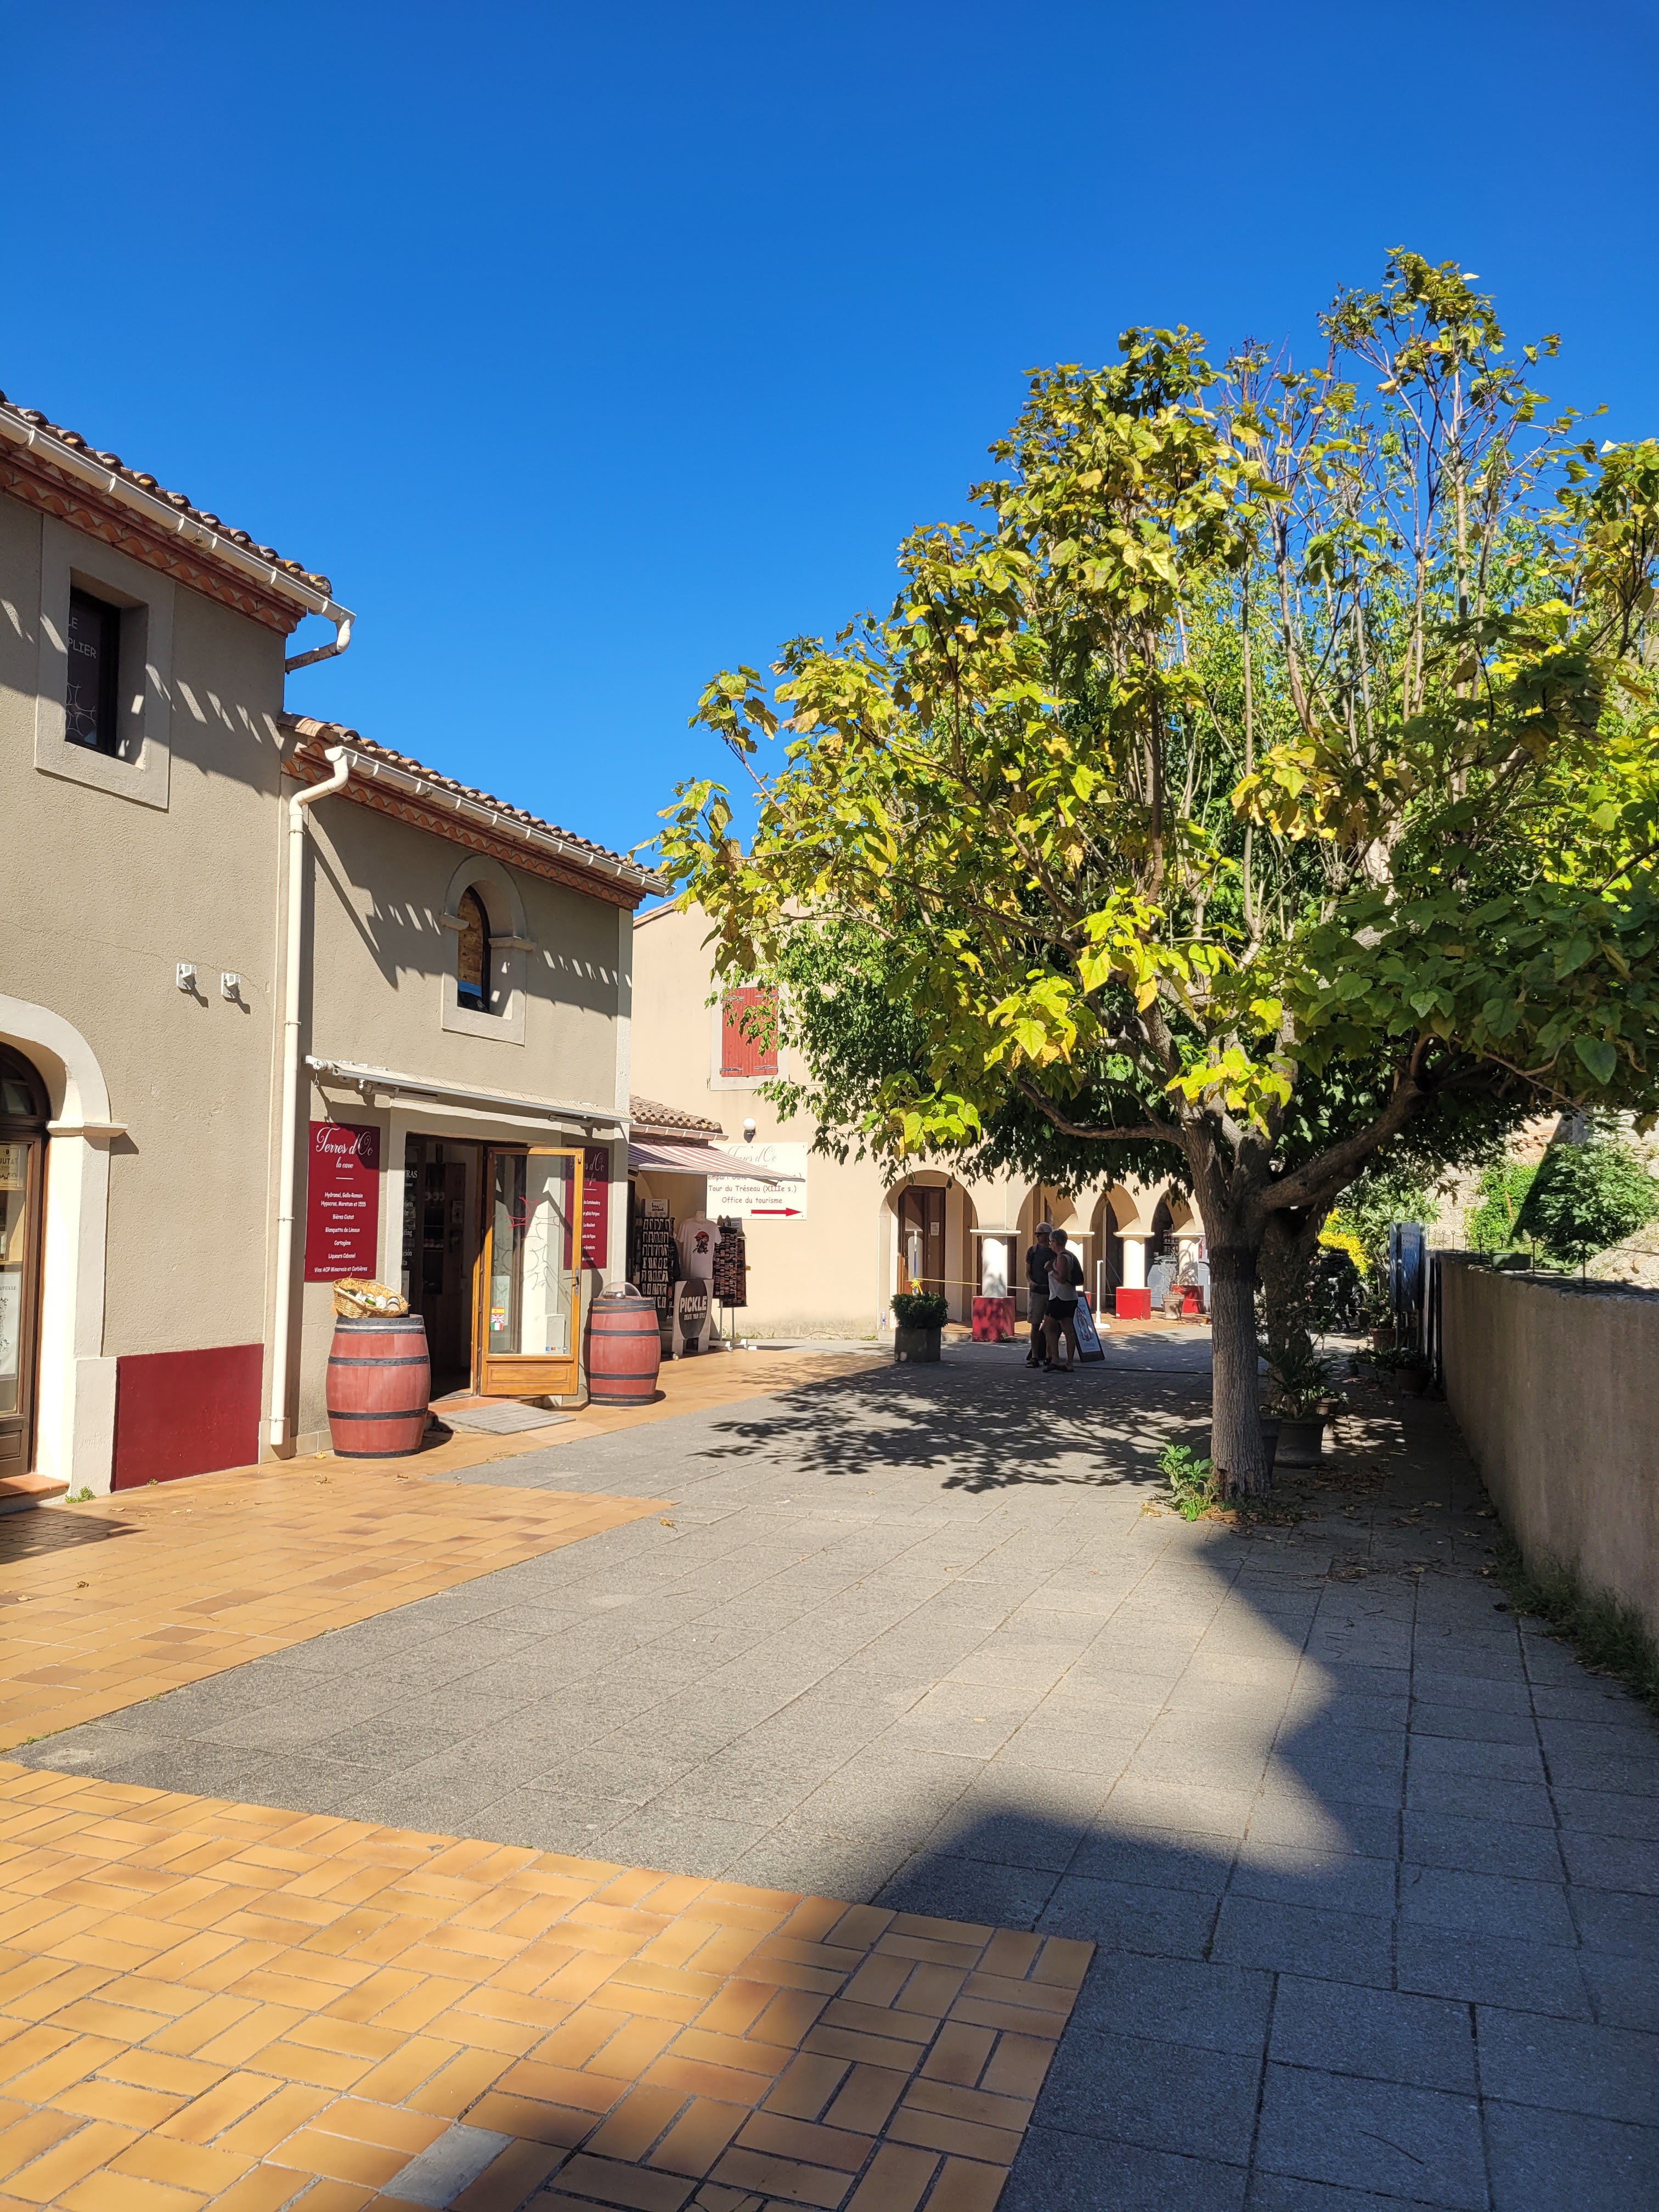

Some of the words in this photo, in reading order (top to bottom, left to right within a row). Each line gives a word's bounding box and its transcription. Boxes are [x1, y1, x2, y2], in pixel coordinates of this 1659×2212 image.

[316, 1127, 348, 1154] Terres
[336, 1156, 341, 1168] la
[405, 1170, 417, 1178] RAS
[680, 1295, 707, 1313] PICKLE
